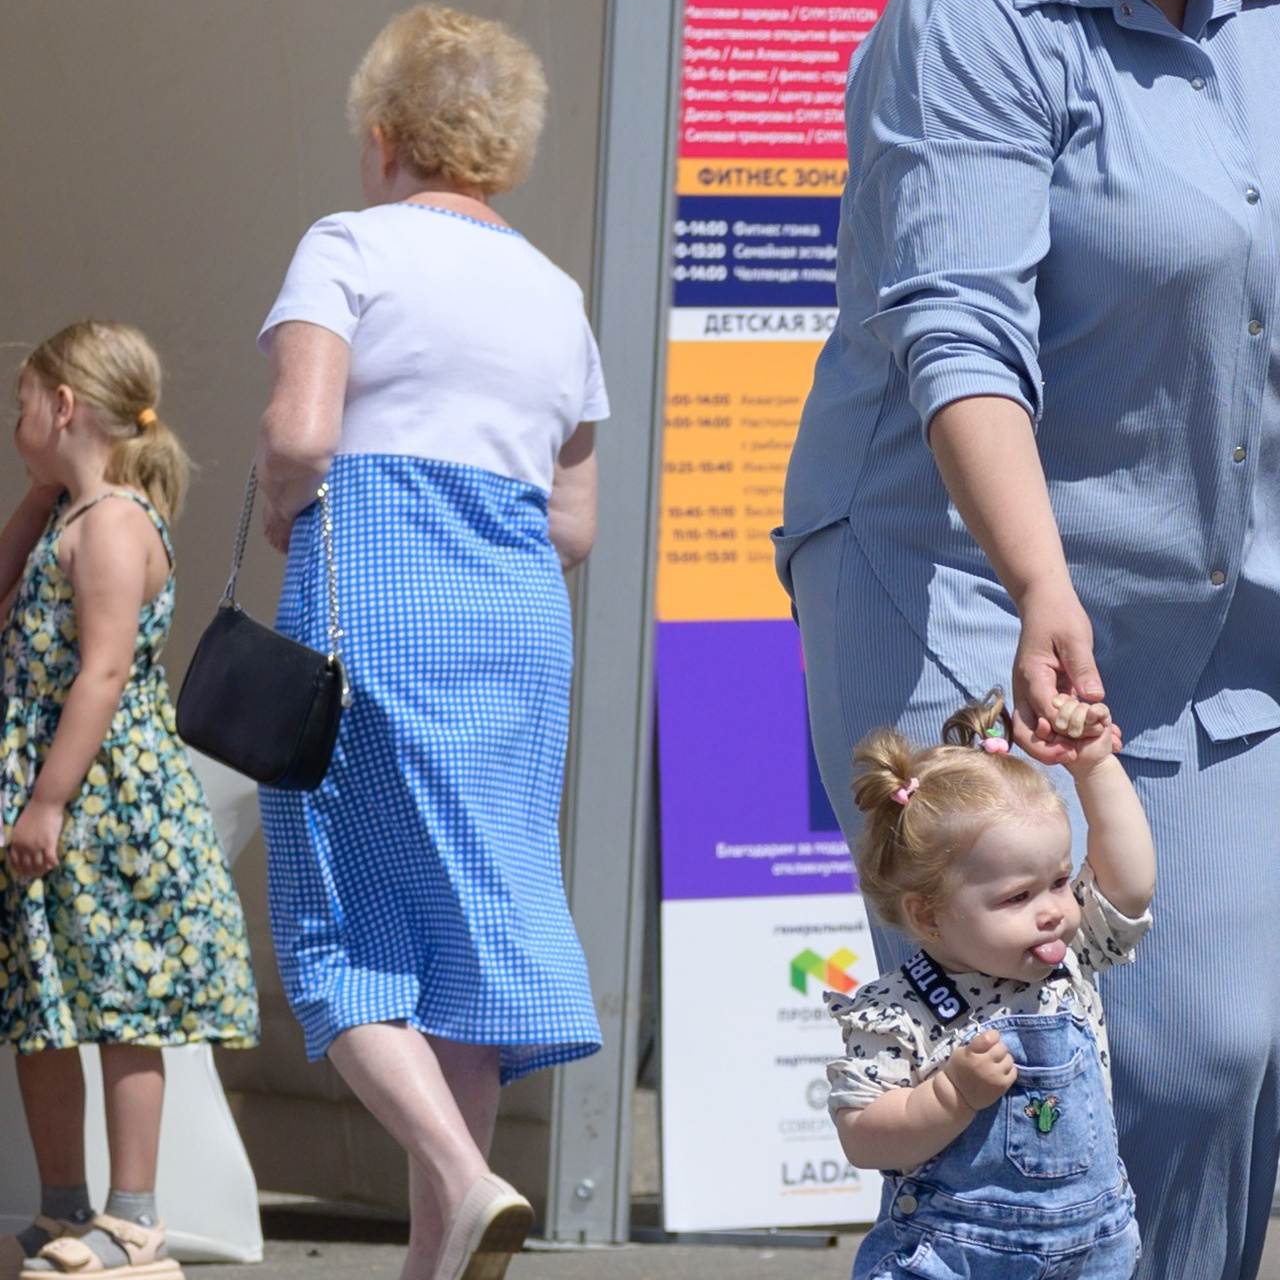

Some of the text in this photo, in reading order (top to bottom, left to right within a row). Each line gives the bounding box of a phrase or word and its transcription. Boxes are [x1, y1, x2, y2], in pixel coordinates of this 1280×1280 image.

[698, 168, 787, 186] ФИТНЕС
[704, 314, 804, 335] ДЕТСКАЯ
[929, 983, 963, 1020] GO
[781, 1160, 860, 1186] LADA
